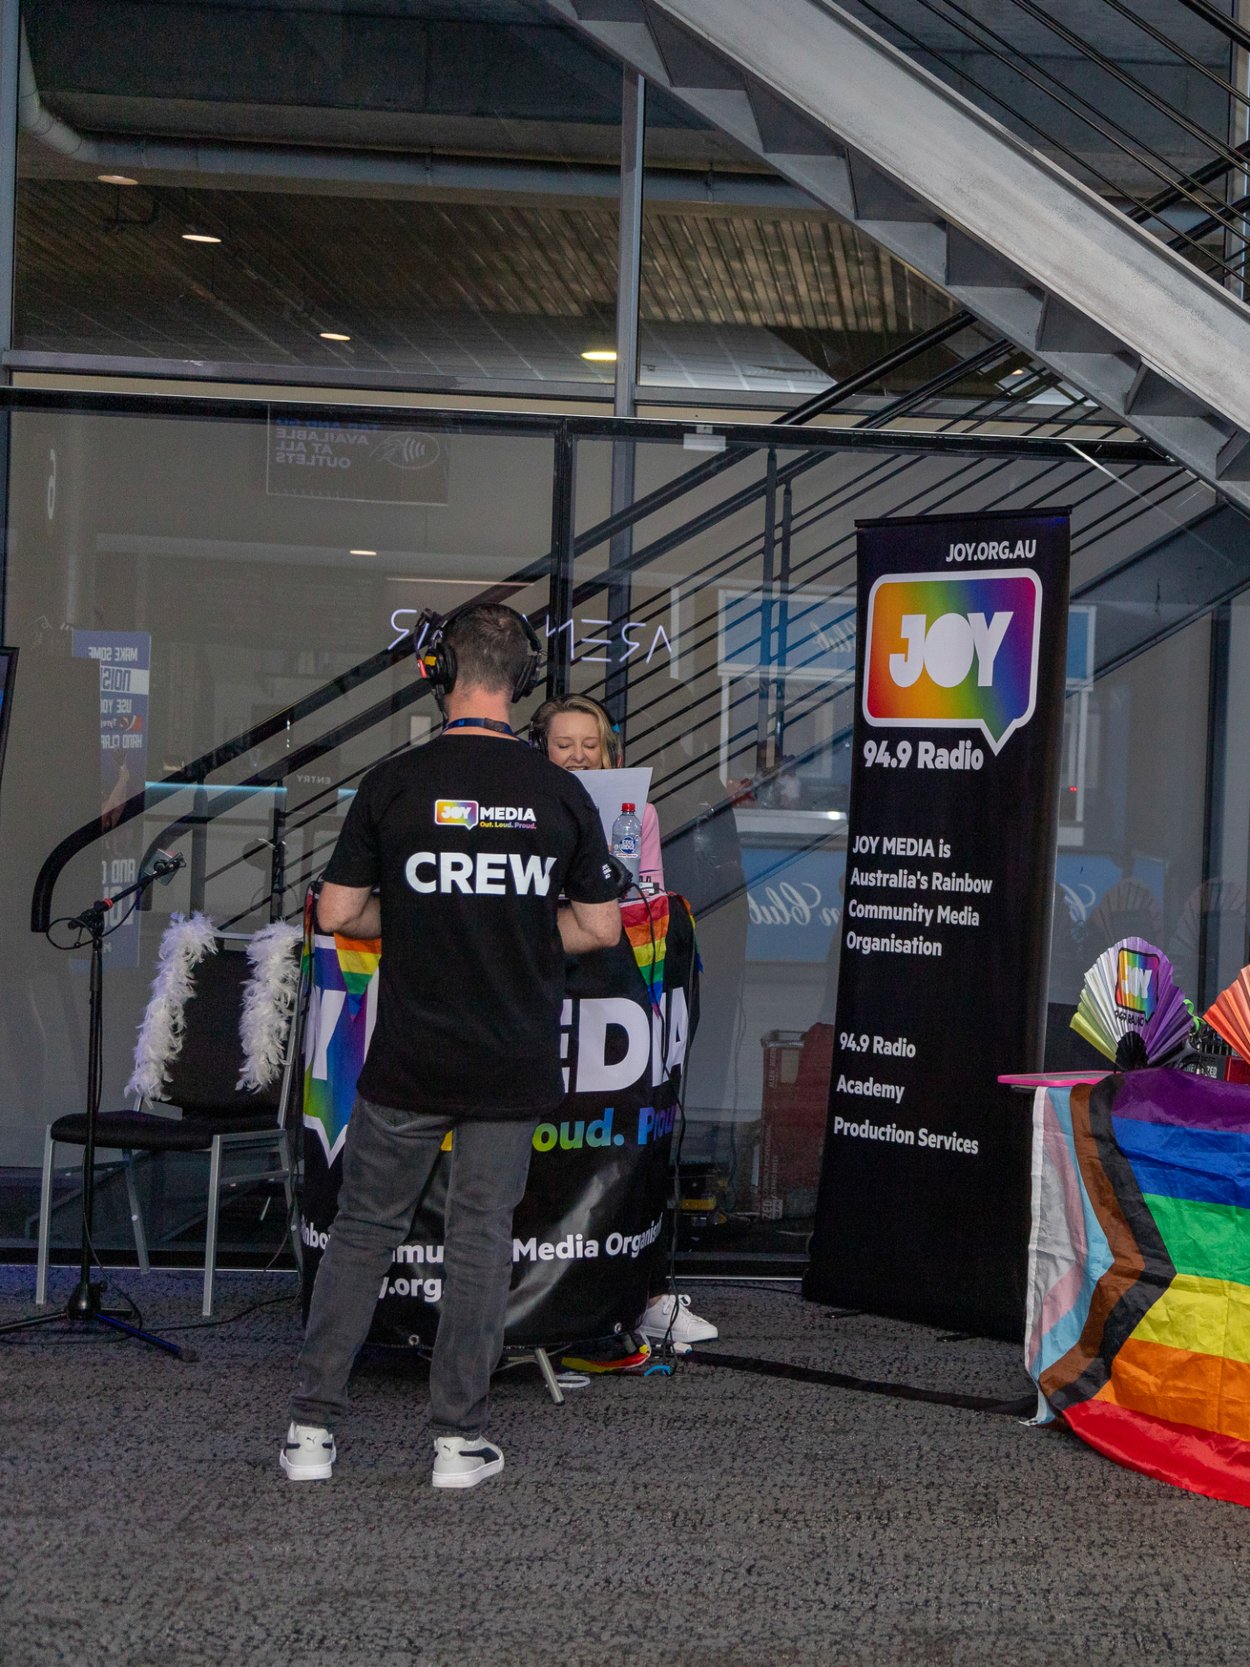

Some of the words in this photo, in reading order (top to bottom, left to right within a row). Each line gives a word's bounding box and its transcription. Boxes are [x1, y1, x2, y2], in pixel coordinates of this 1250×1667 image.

[945, 539, 1037, 563] JOY.ORG.AU
[889, 611, 1013, 688] JOY
[862, 741, 912, 769] 94.9
[917, 740, 984, 771] Radio
[441, 805, 472, 819] JOY
[480, 807, 536, 821] MEDIA
[852, 836, 879, 857] JOY
[882, 838, 935, 859] MEDIA
[938, 840, 951, 859] is
[405, 852, 558, 896] CREW
[850, 866, 929, 891] Australia's
[932, 872, 993, 895] Rainbow
[848, 900, 934, 926] Community
[938, 904, 980, 927] Media
[846, 931, 942, 957] Organisation
[838, 1032, 869, 1055] 94.9
[872, 1036, 916, 1059] Radio
[836, 1074, 905, 1104] Academy
[532, 1108, 625, 1152] oud.
[638, 1104, 677, 1145] Prou
[833, 1116, 914, 1147] Production
[918, 1131, 979, 1155] Services
[513, 1234, 599, 1262] Media
